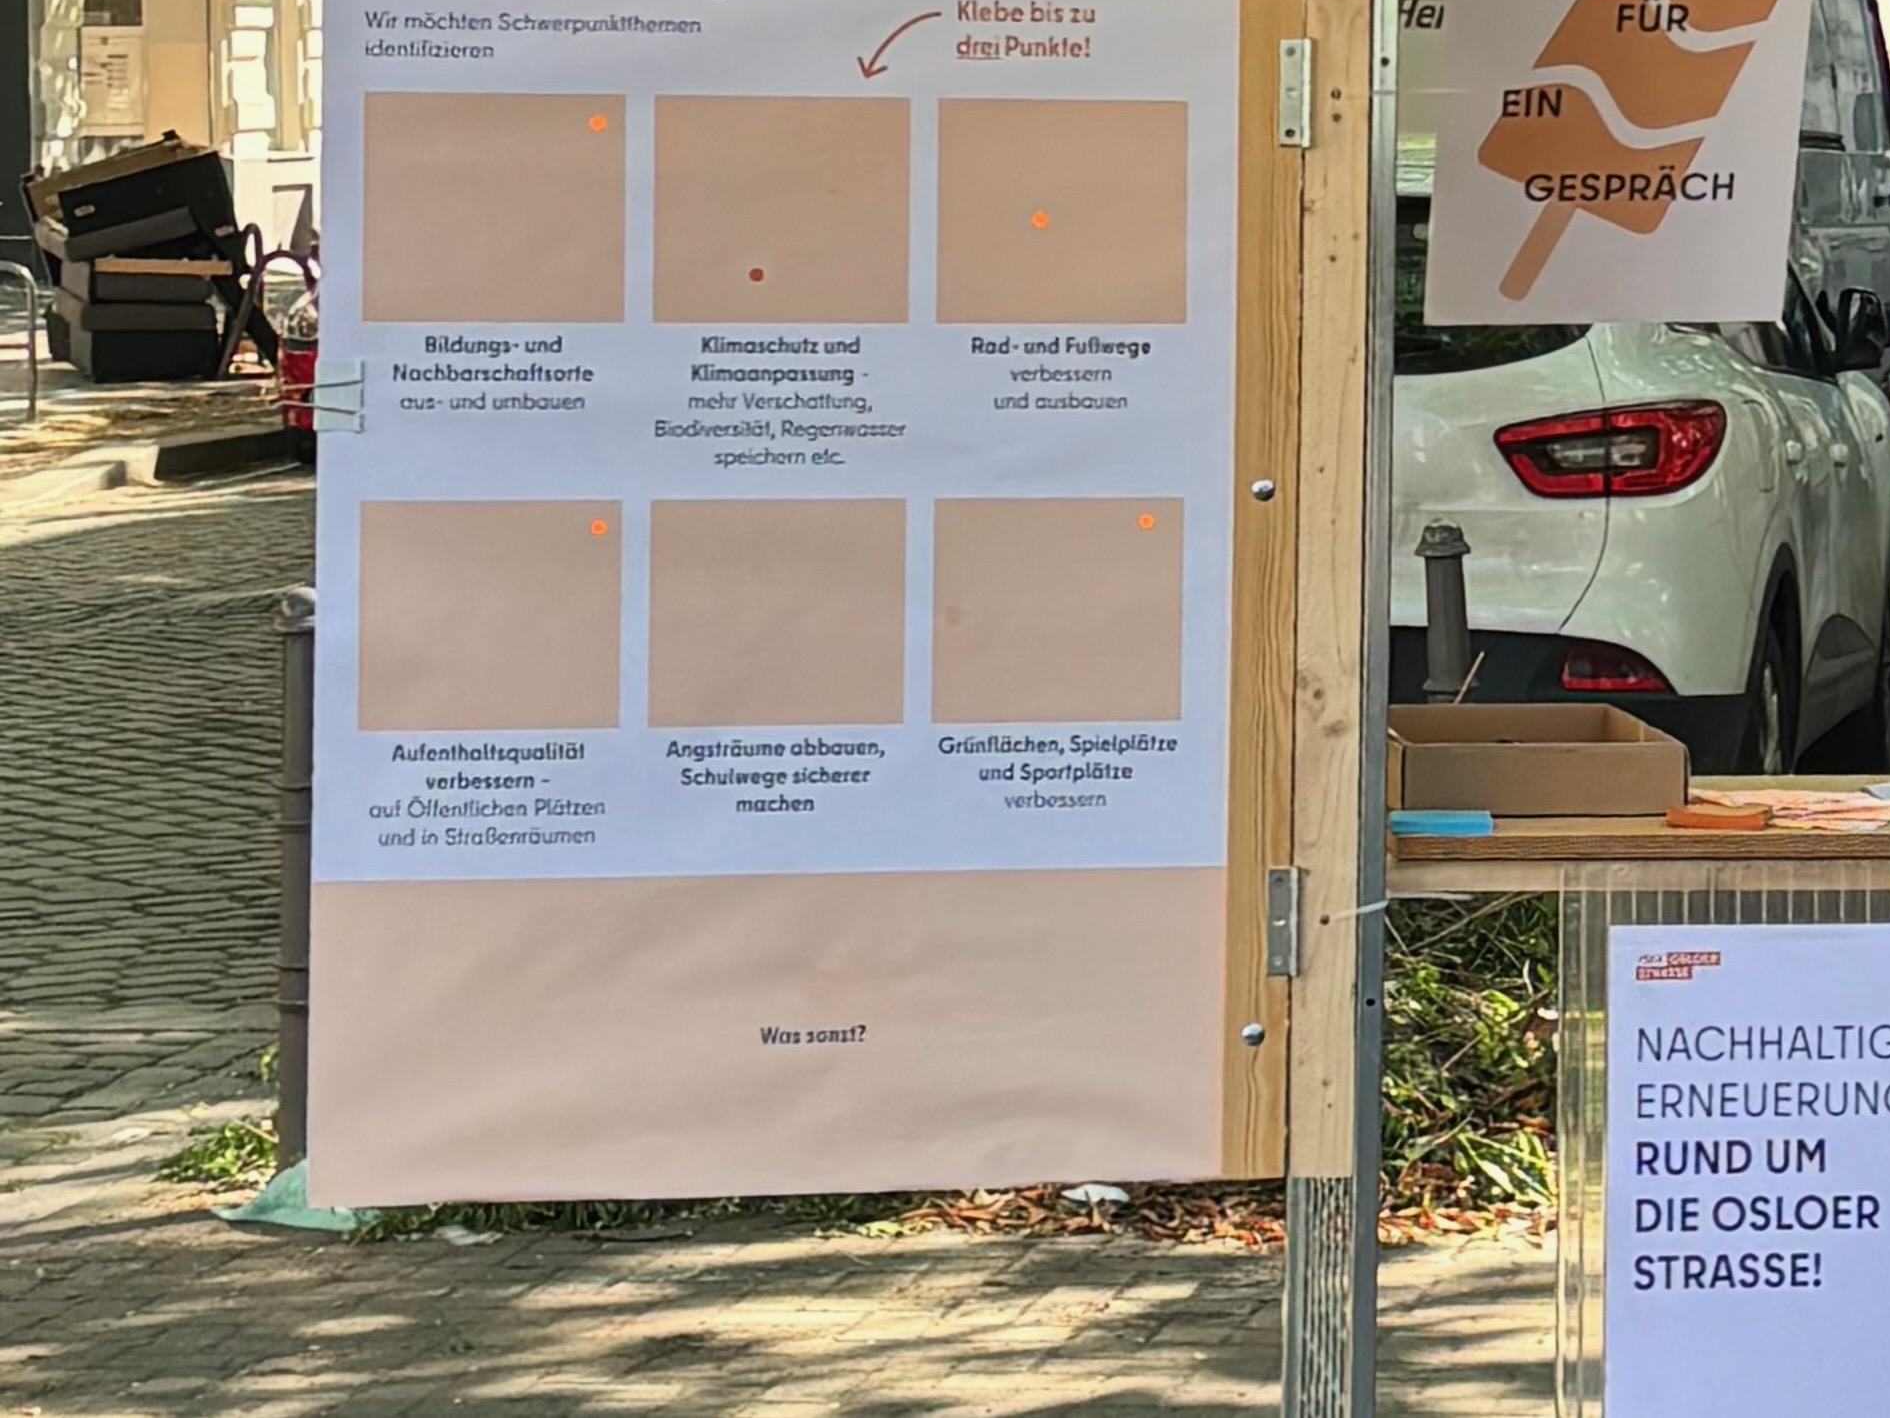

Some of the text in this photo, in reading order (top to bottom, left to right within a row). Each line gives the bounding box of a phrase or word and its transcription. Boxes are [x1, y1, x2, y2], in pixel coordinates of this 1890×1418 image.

[957, 1, 1096, 23] Klebe bis zu
[365, 12, 701, 34] Wir möchten Schwerpunktthemen
[365, 41, 494, 58] identifizieren
[956, 35, 1090, 58] drei Punkte!
[1502, 89, 1562, 118] EIN
[1524, 166, 1735, 202] GESPRÄCH
[425, 336, 563, 357] Bildungs- und
[701, 336, 860, 354] Klimaschutz und
[971, 337, 1151, 358] Rad- und Fußwege
[392, 364, 594, 383] Nachbarschaftsorte
[691, 364, 854, 385] Klimaanpassung
[1010, 365, 1112, 382] verbessern
[400, 393, 585, 410] aus- und umbauen
[688, 392, 872, 413] mehr Verschattung,
[994, 392, 1128, 409] und ausbauen
[654, 420, 906, 441] Biodiversität, Regenwasser
[714, 448, 845, 468] speichern etc.
[391, 742, 585, 763] Aufenthaltsqualität
[666, 738, 885, 762] Angsträume abbauen,
[938, 734, 1178, 756] Grünflächen, Spielplätze
[426, 772, 535, 790] verbessern
[680, 767, 871, 788] Schulwege sicherer
[979, 762, 1133, 784] und Sportplätze
[369, 796, 606, 818] auf Öffentlichen Plätzen
[736, 794, 815, 812] machen
[1004, 791, 1107, 809] verbessern
[378, 827, 596, 846] und in Straßenräumen
[760, 1024, 867, 1044] Was sonst?
[1636, 1138, 1826, 1175] RUND UM
[1635, 1194, 1880, 1232] DIE OSLOER
[1633, 1252, 1822, 1290] STRASSE!
